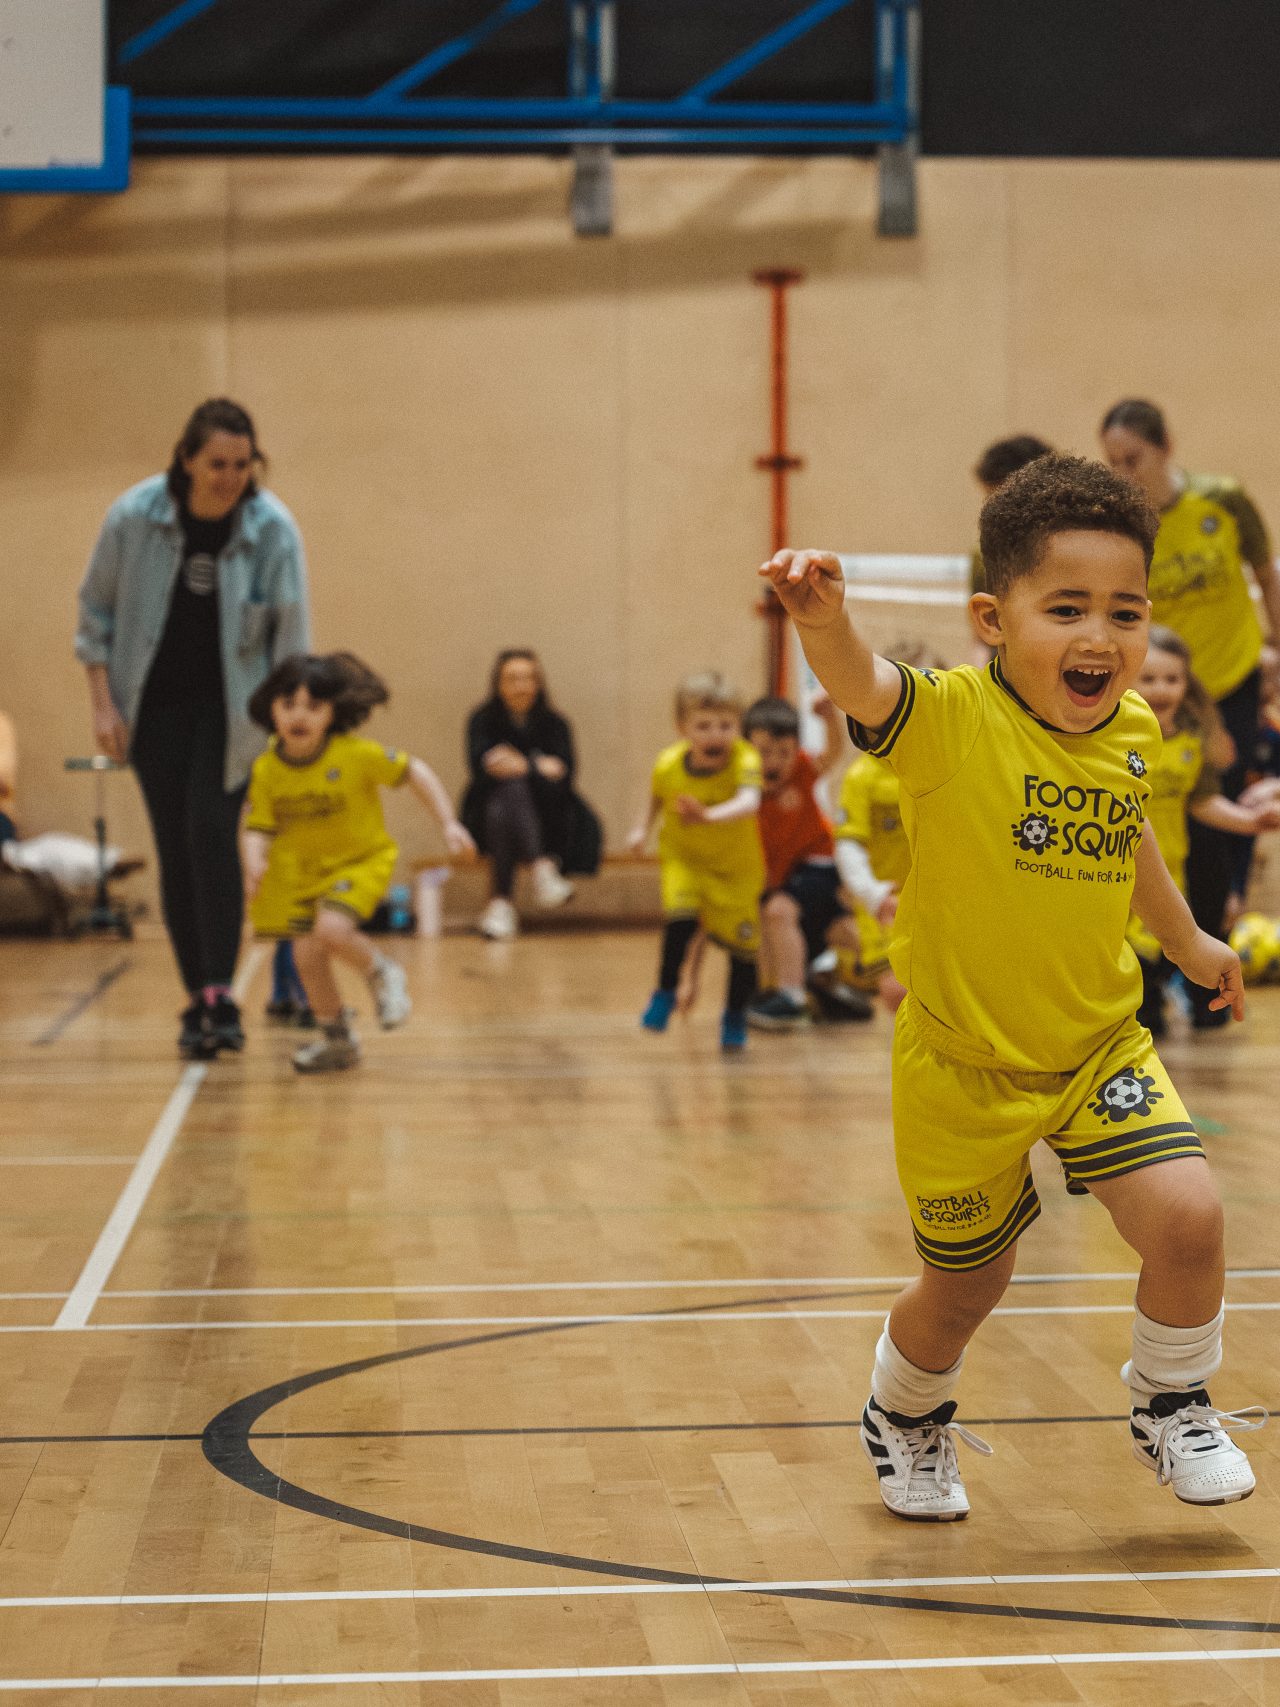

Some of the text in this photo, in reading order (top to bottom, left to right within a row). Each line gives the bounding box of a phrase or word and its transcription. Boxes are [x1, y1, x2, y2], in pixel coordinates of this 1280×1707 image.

[1015, 858, 1074, 880] FOOTBALL
[1078, 869, 1095, 881] FUN
[1097, 870, 1113, 884] FOR
[916, 1190, 989, 1211] FOOTBALL
[934, 1200, 991, 1223] SQUIRTS
